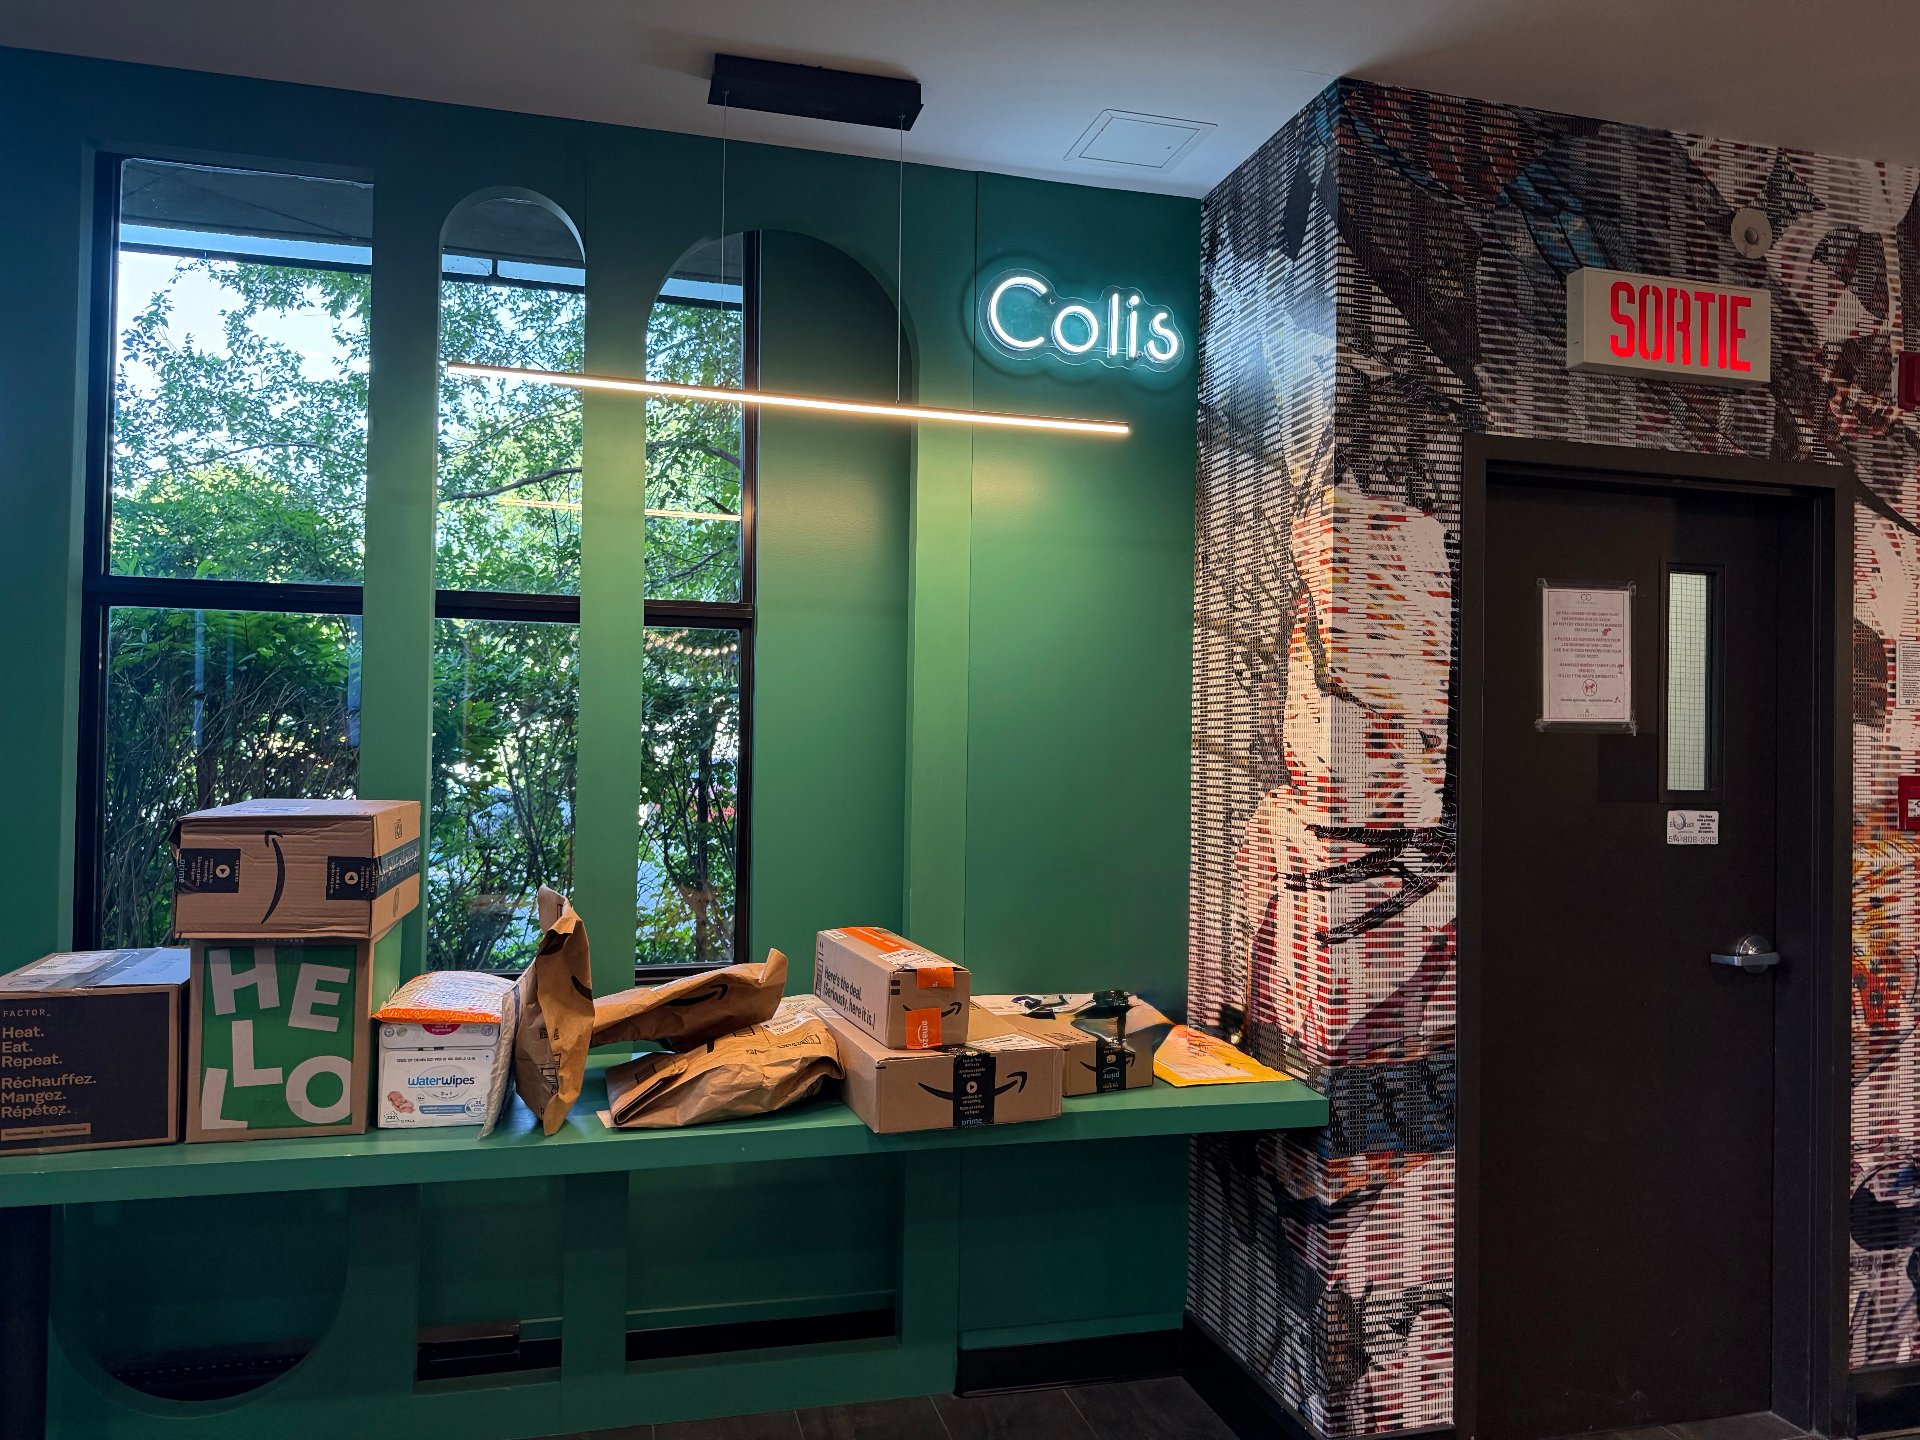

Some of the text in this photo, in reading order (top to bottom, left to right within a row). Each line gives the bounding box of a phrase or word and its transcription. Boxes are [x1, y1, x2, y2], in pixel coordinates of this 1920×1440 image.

[988, 276, 1178, 362] Colis
[1610, 281, 1751, 372] SORTIE
[841, 976, 850, 993] the
[2, 1026, 45, 1039] Heat.
[2, 1041, 33, 1053] Eat.
[2, 1054, 63, 1069] Repeat.
[1, 1073, 97, 1089] Réchauffez.
[1, 1091, 67, 1104] Mangez.
[1, 1105, 71, 1119] Répétez.
